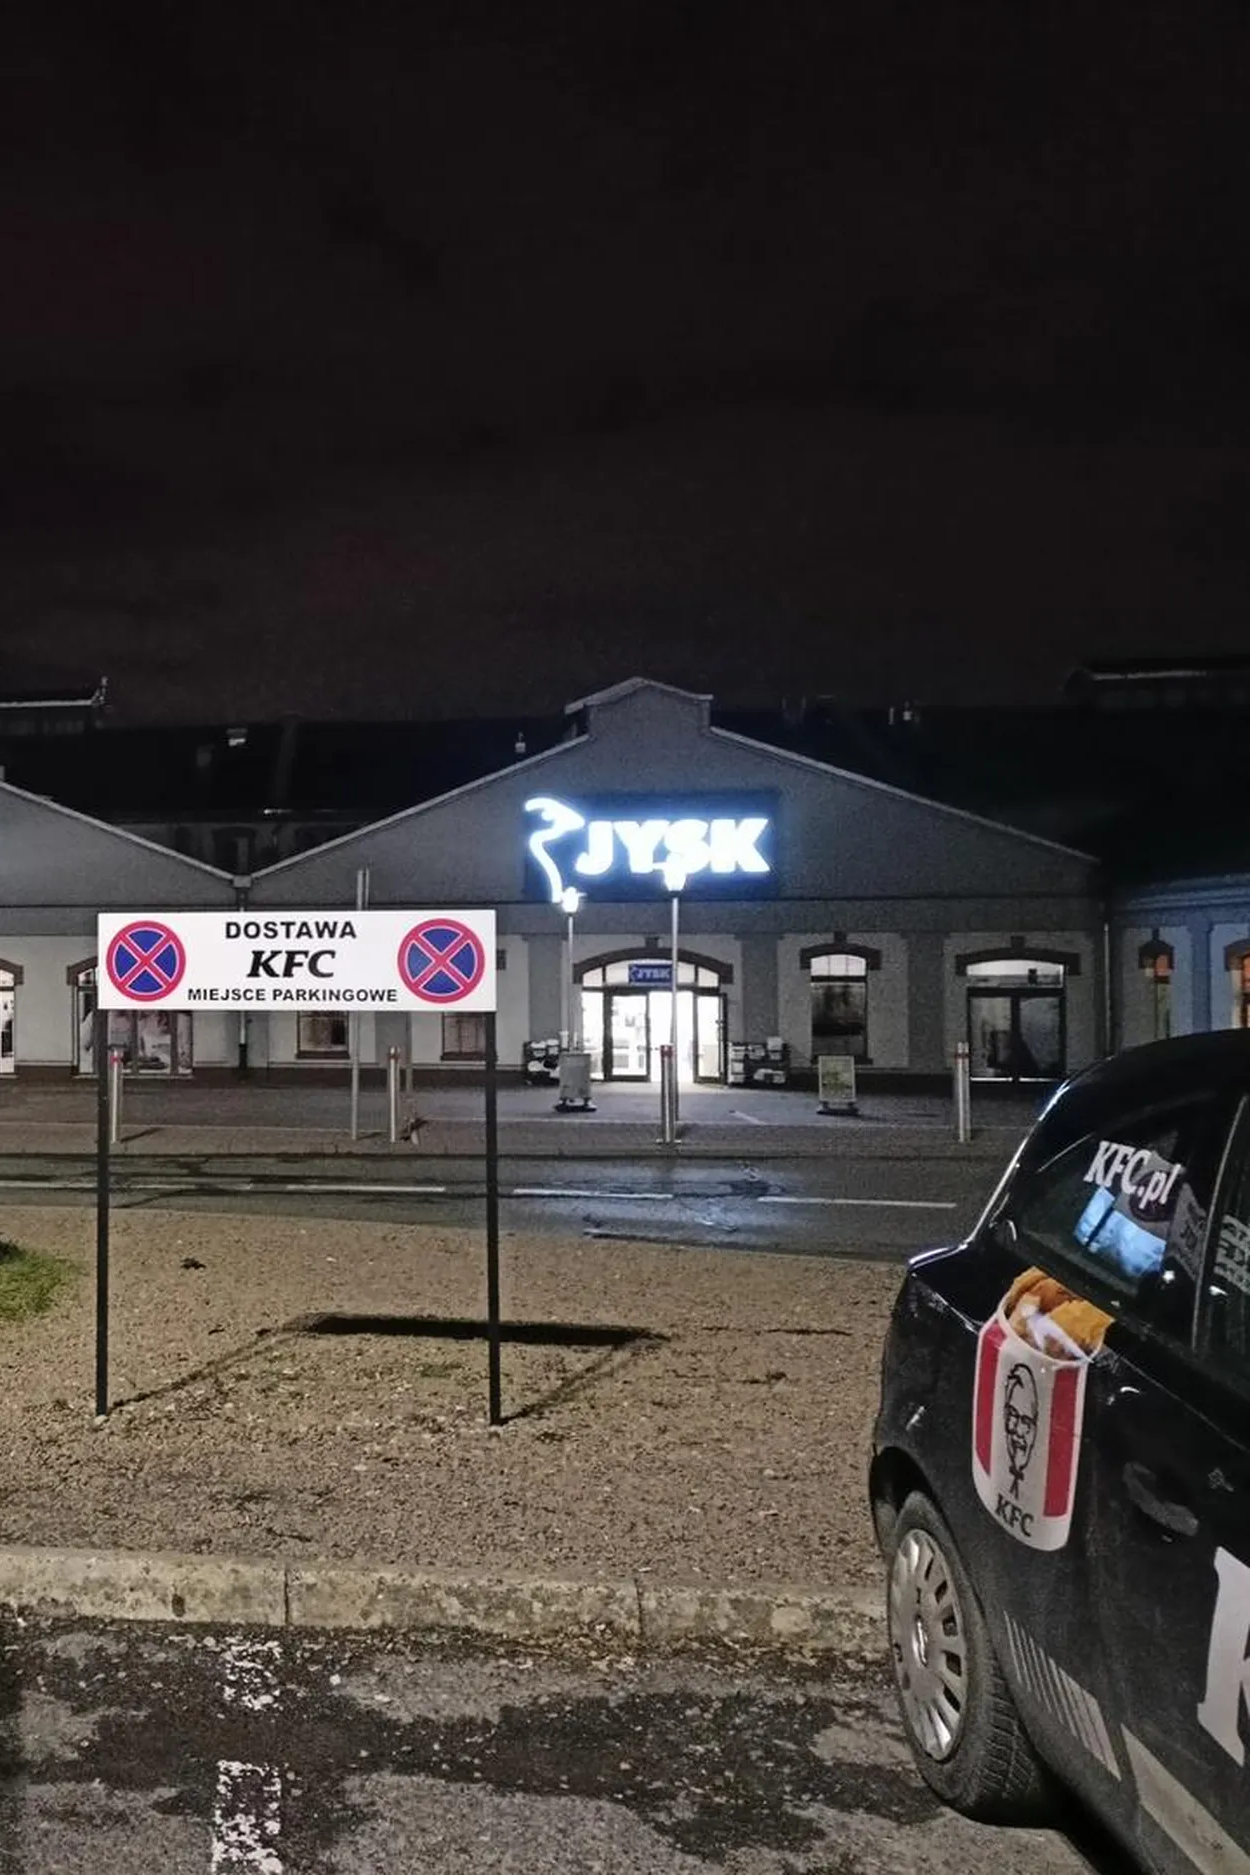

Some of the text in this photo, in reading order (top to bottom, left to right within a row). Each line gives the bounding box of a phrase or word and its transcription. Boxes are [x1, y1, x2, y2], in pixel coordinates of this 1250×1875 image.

[574, 817, 771, 875] JYSK
[224, 920, 357, 940] DOSTAWA
[246, 949, 336, 979] KFC
[187, 987, 398, 1003] MIEJSCE PARKINGOWE
[1082, 1140, 1182, 1210] KFC.pl
[994, 1493, 1035, 1538] KFC
